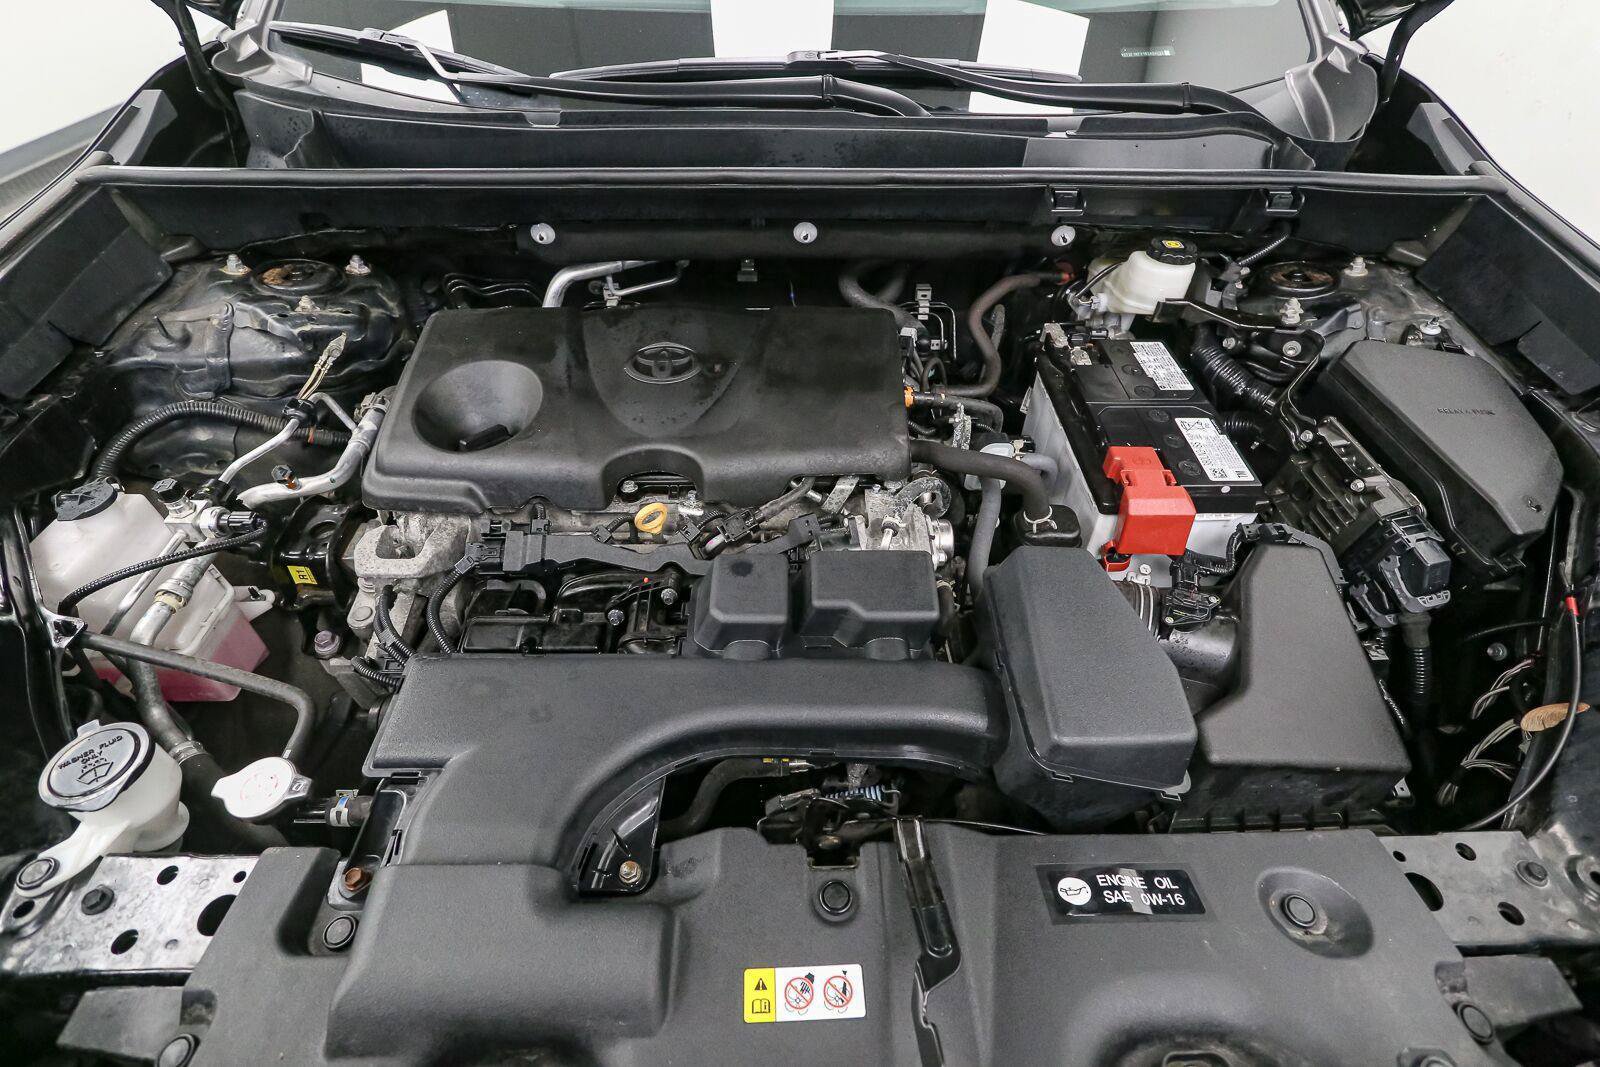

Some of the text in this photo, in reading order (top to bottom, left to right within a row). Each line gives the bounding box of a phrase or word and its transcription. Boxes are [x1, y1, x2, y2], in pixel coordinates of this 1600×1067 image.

[58, 735, 123, 770] WASHER FLUID
[81, 750, 103, 765] ONLY
[1096, 874, 1180, 889] ENGINE OIL
[1103, 890, 1186, 906] SAE 0W-16
